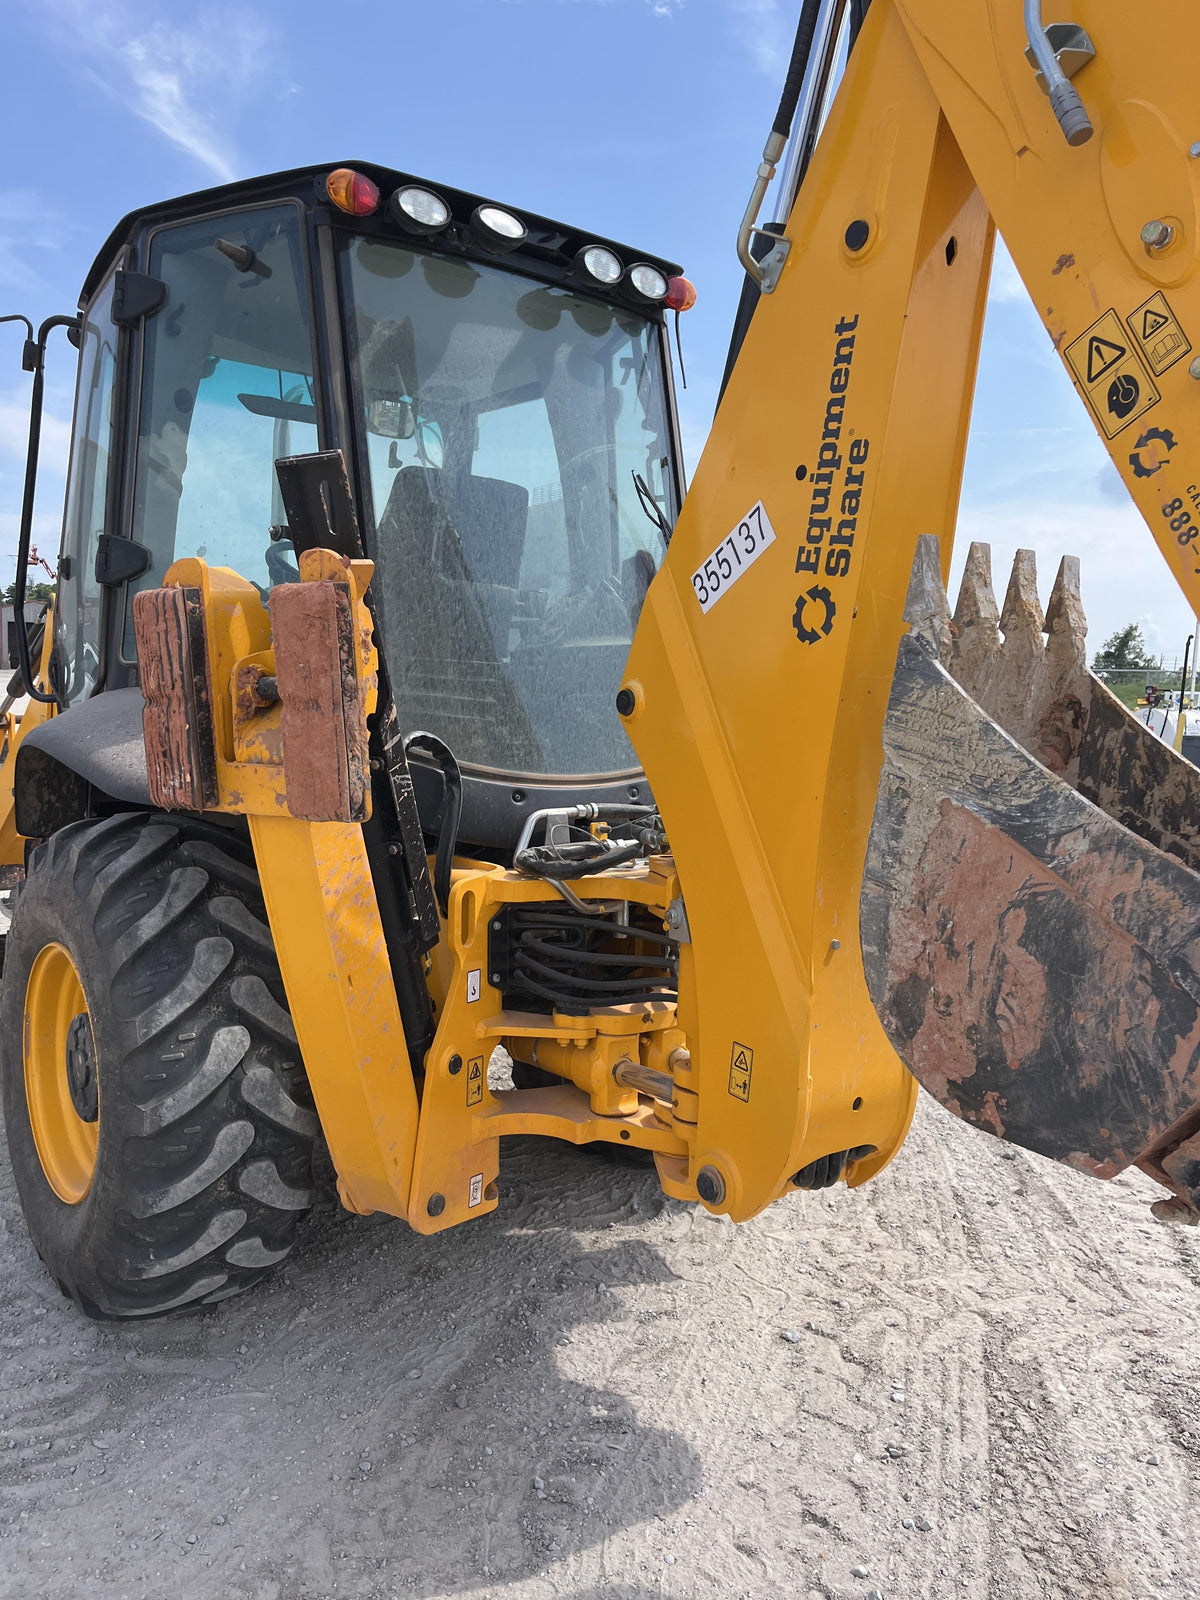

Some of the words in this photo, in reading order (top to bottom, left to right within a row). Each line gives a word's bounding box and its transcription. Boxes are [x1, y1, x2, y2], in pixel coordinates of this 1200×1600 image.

[795, 314, 859, 574] Equipment
[693, 505, 765, 605] 355137
[825, 439, 869, 577] Share
[1161, 497, 1200, 574] 888-
